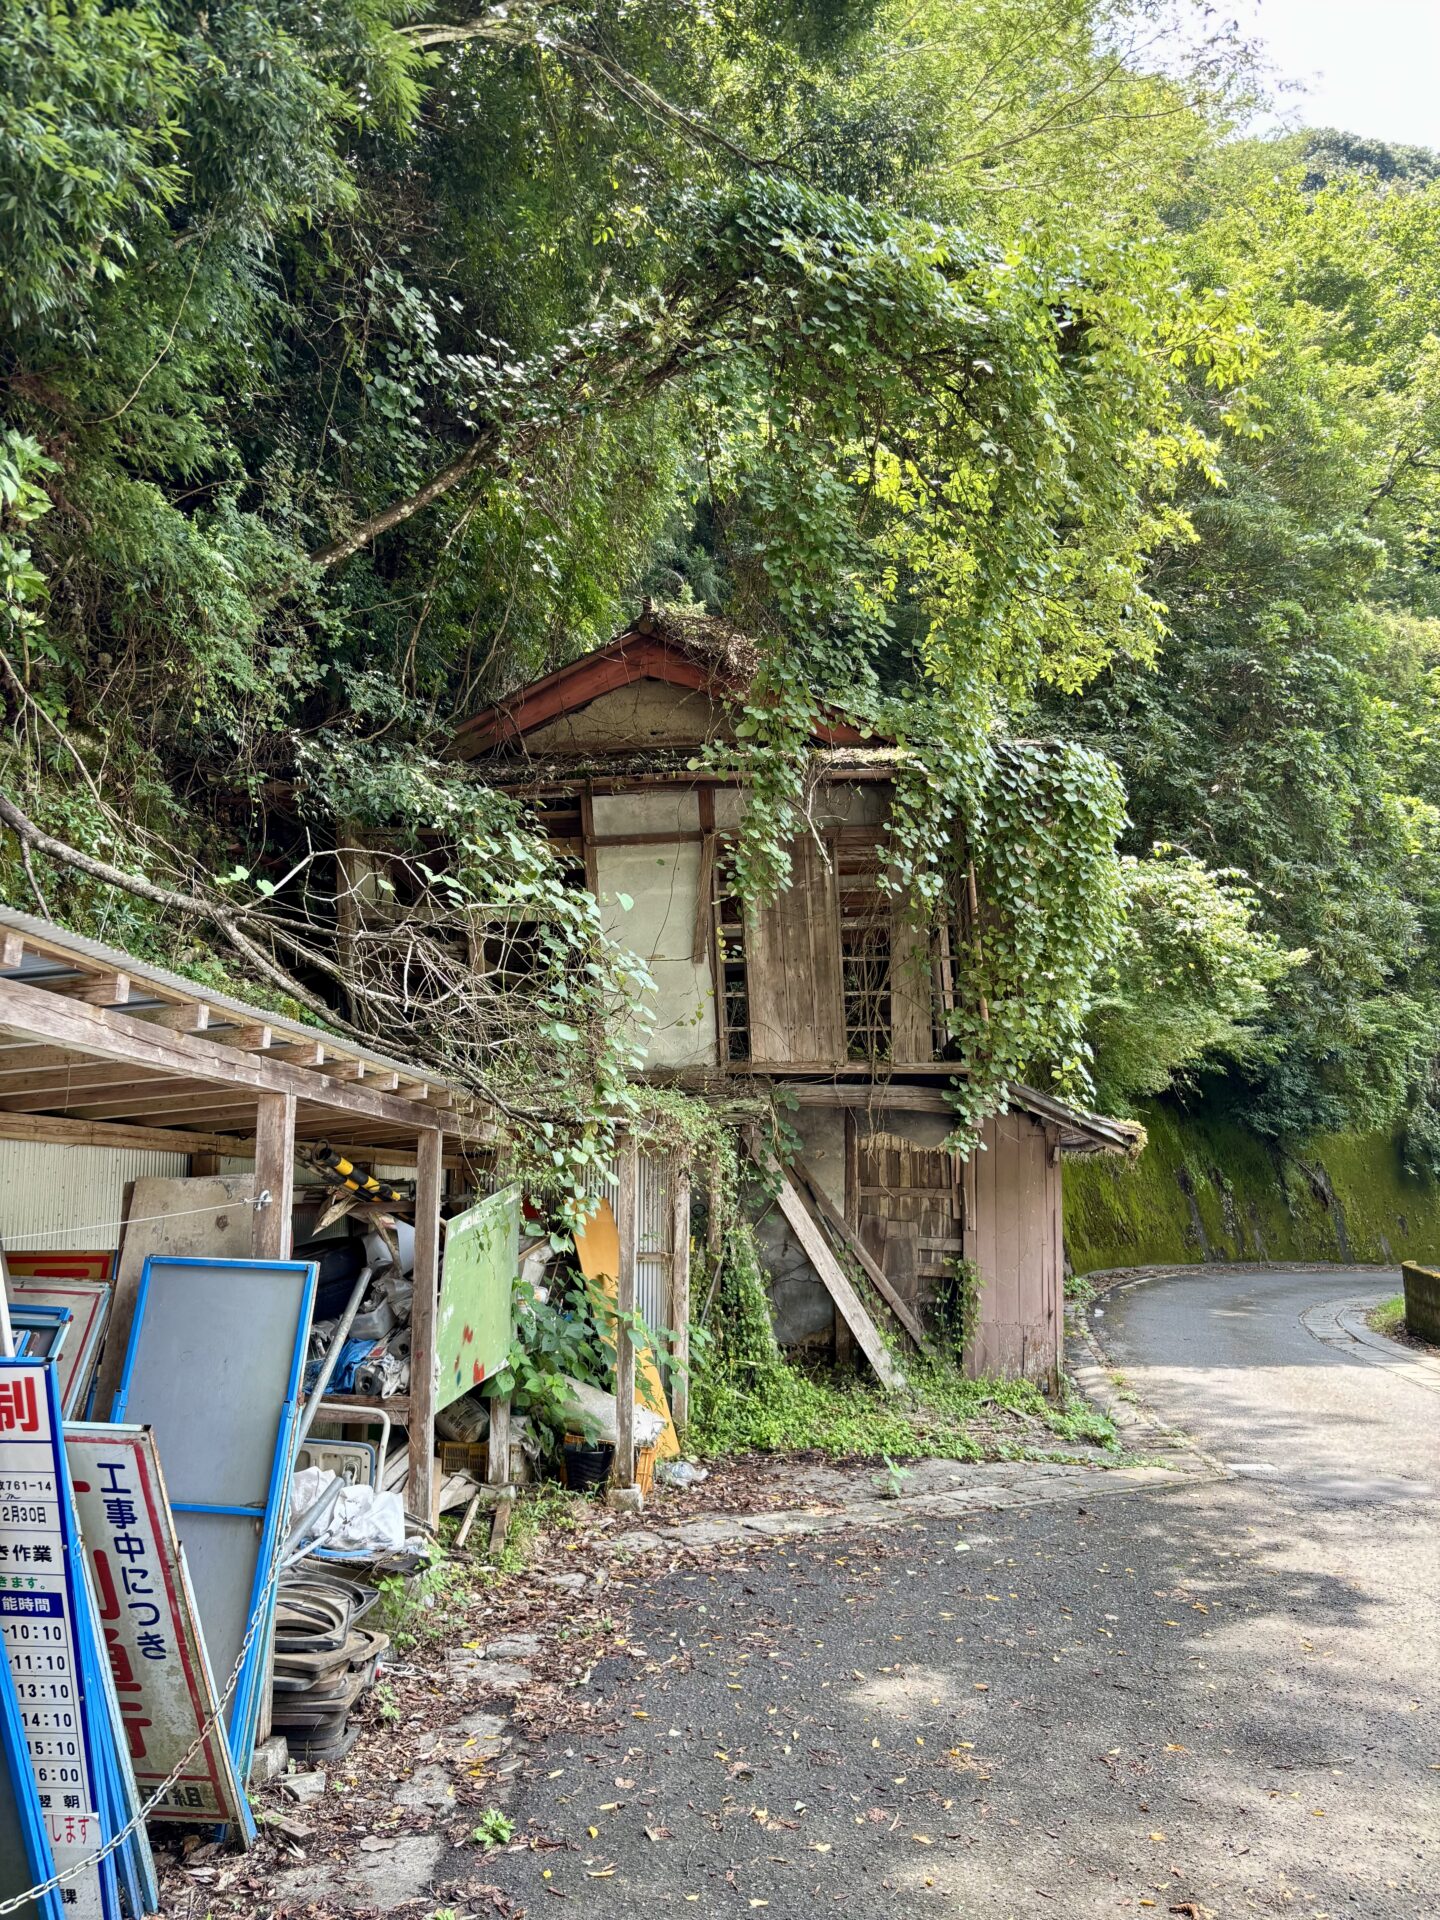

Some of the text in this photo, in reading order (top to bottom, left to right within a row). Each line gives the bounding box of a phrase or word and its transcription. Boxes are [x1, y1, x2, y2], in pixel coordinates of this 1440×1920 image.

[2, 1506, 46, 1523] 2月30日
[97, 1463, 167, 1660] 工事中につき
[2, 1597, 51, 1612] 能時間
[18, 1684, 69, 1698] 13:10
[21, 1713, 72, 1727] 14:10
[33, 1767, 79, 1782] 6:00
[43, 1814, 89, 1844] します
